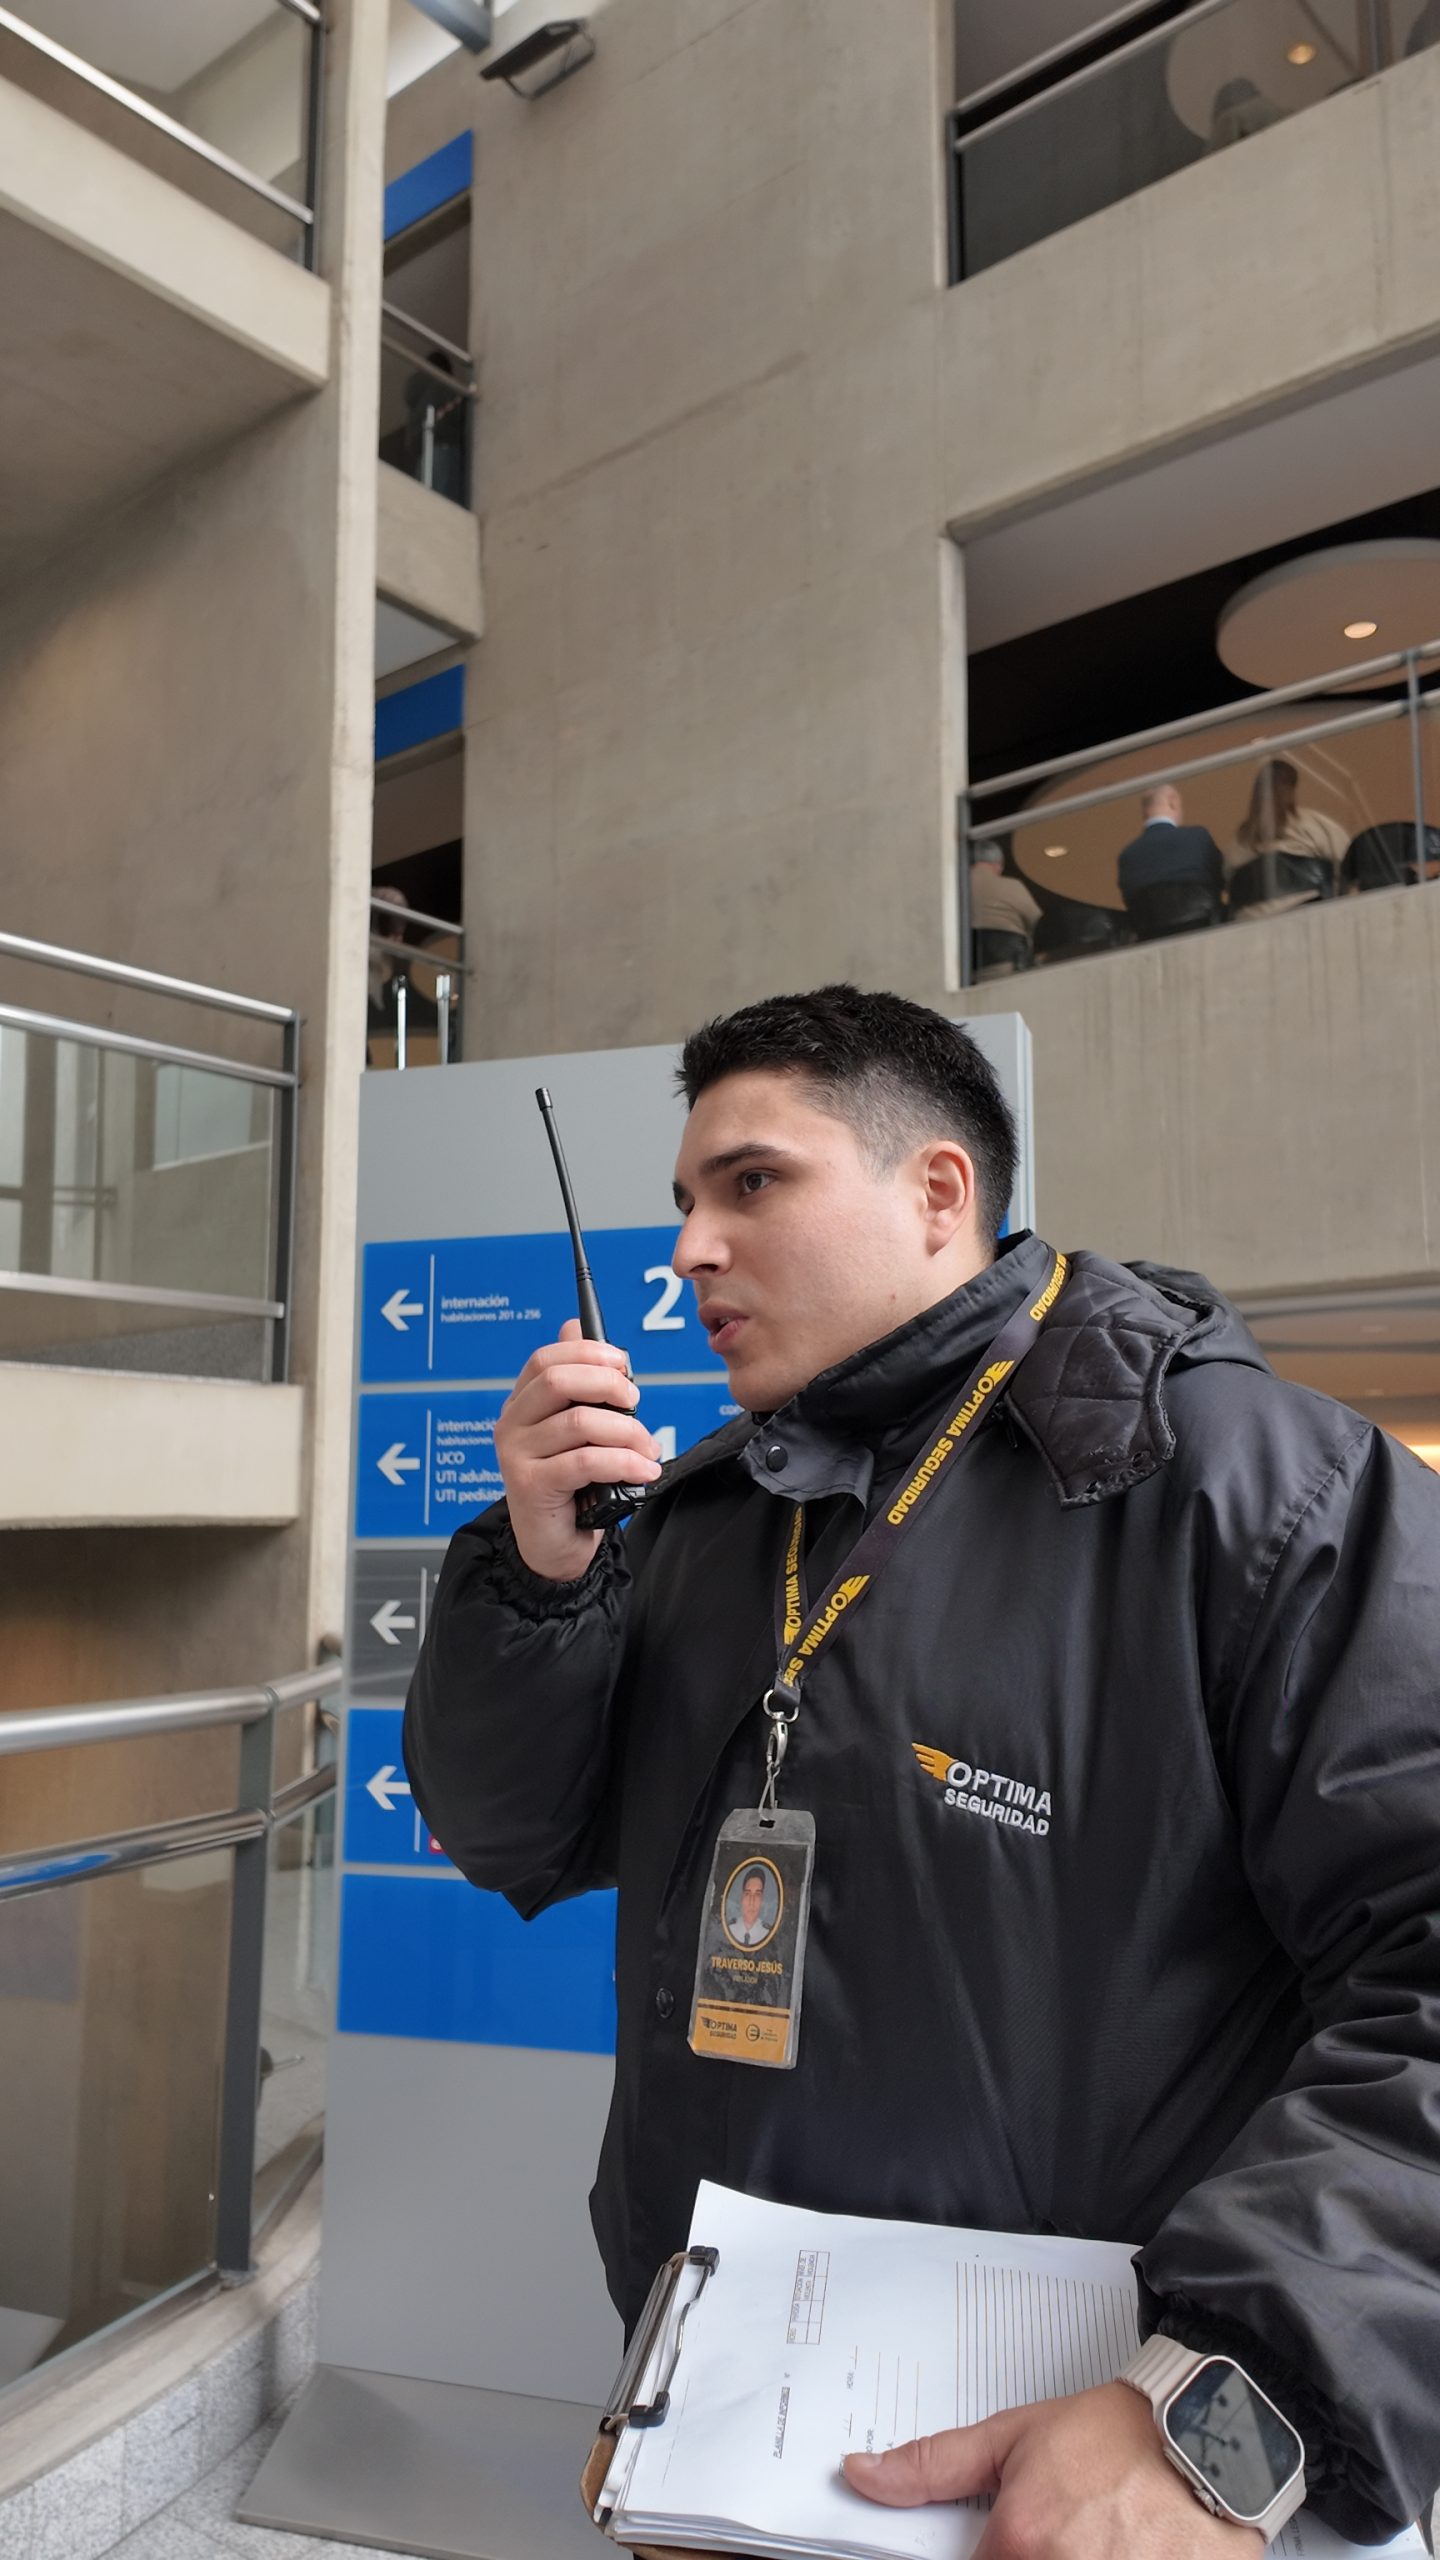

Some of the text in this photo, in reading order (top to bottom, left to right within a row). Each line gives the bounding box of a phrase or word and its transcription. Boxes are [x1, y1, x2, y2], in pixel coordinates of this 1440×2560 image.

[440, 1311, 497, 1323] habitaciones
[441, 1293, 510, 1310] internación
[643, 1265, 685, 1331] 2
[437, 1417, 497, 1432] internació
[436, 1451, 466, 1465] UCO
[887, 1376, 994, 1526] OPTIMA SEGURIDAD
[785, 1574, 802, 1629] OPTIMA
[797, 1592, 848, 1656] OPTIMA
[943, 1788, 1050, 1836] SEGURIDAD
[947, 1761, 1052, 1816] OPTIMA
[711, 1956, 755, 1972] TRAVERSO
